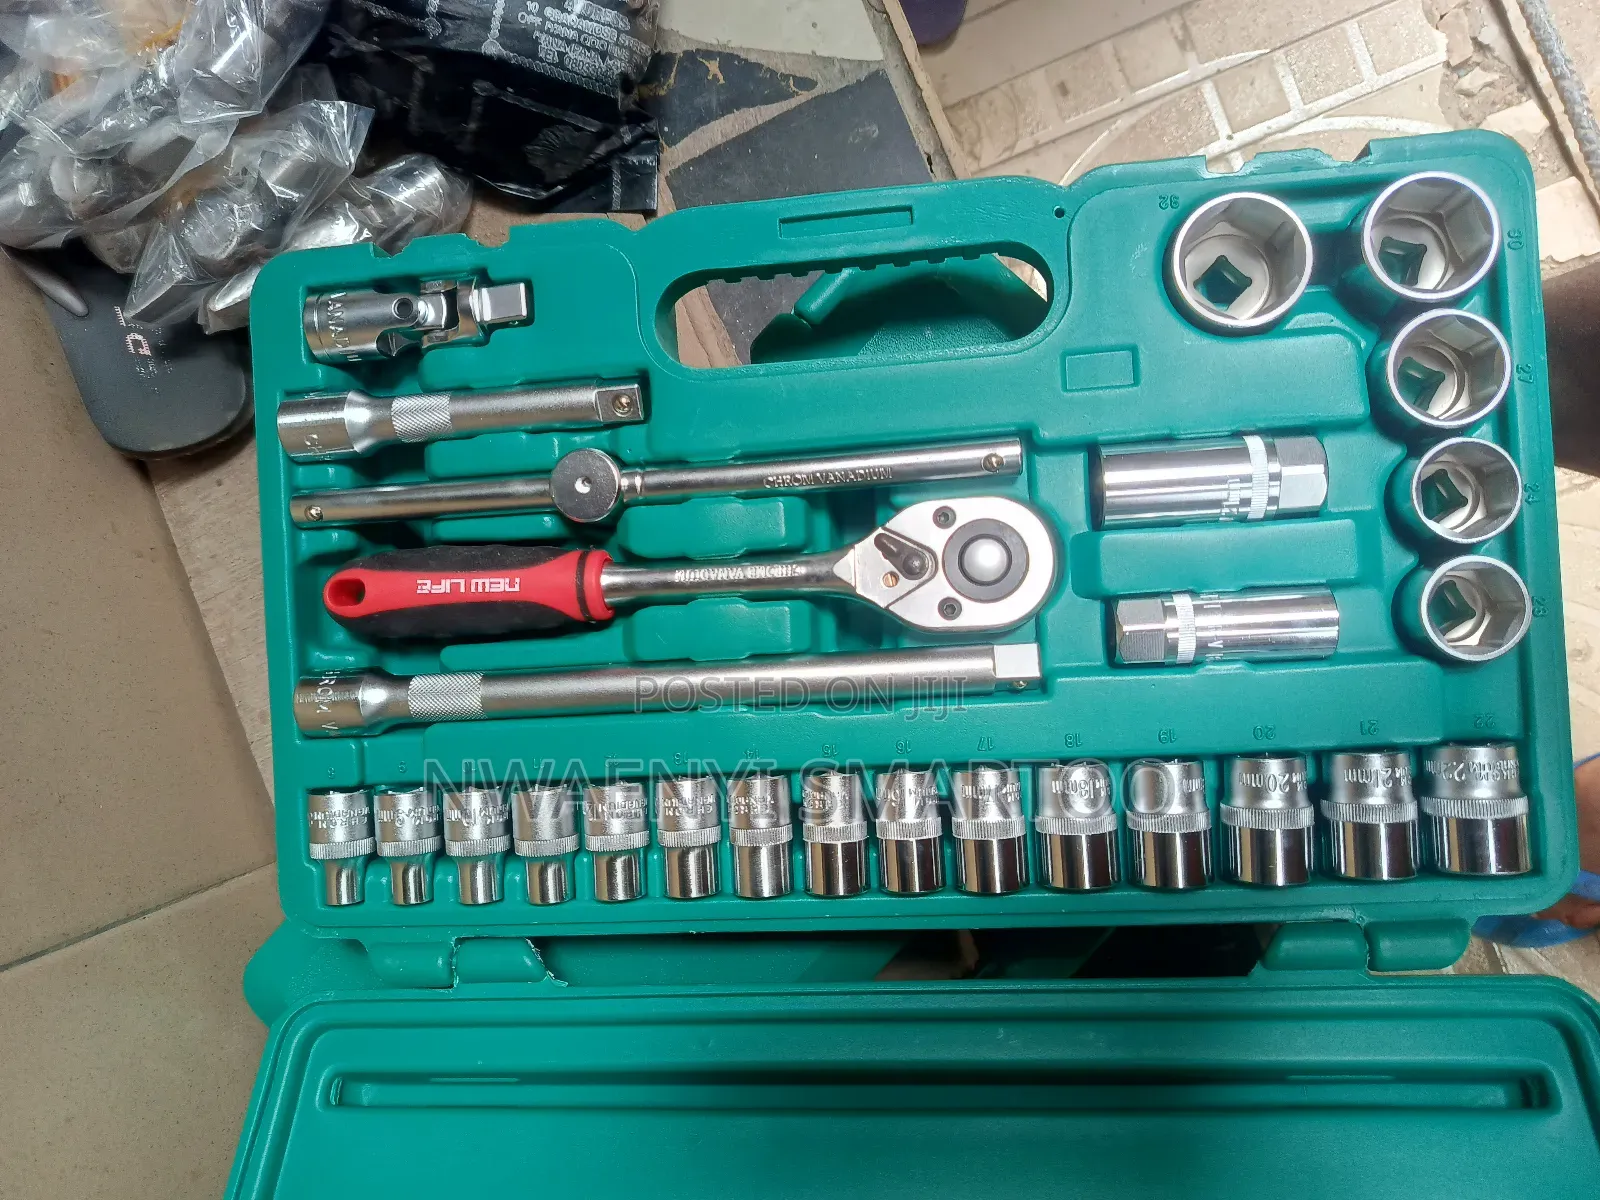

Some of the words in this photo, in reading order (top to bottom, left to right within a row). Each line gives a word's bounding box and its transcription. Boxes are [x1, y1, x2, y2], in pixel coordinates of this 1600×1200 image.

[1158, 194, 1180, 210] 32
[1506, 227, 1524, 251] 30
[1515, 363, 1535, 384] 27
[763, 473, 815, 488] CHROM
[816, 467, 893, 484] VANADIUM
[416, 579, 466, 594] LIFE
[470, 577, 520, 593] NEW
[1356, 719, 1379, 736] 21
[1473, 712, 1496, 729] 22
[1064, 733, 1083, 748] 18
[1158, 728, 1177, 744] 19
[1252, 725, 1277, 740] 20
[822, 744, 839, 757] 15
[895, 740, 912, 754] 16
[977, 736, 995, 751] 17
